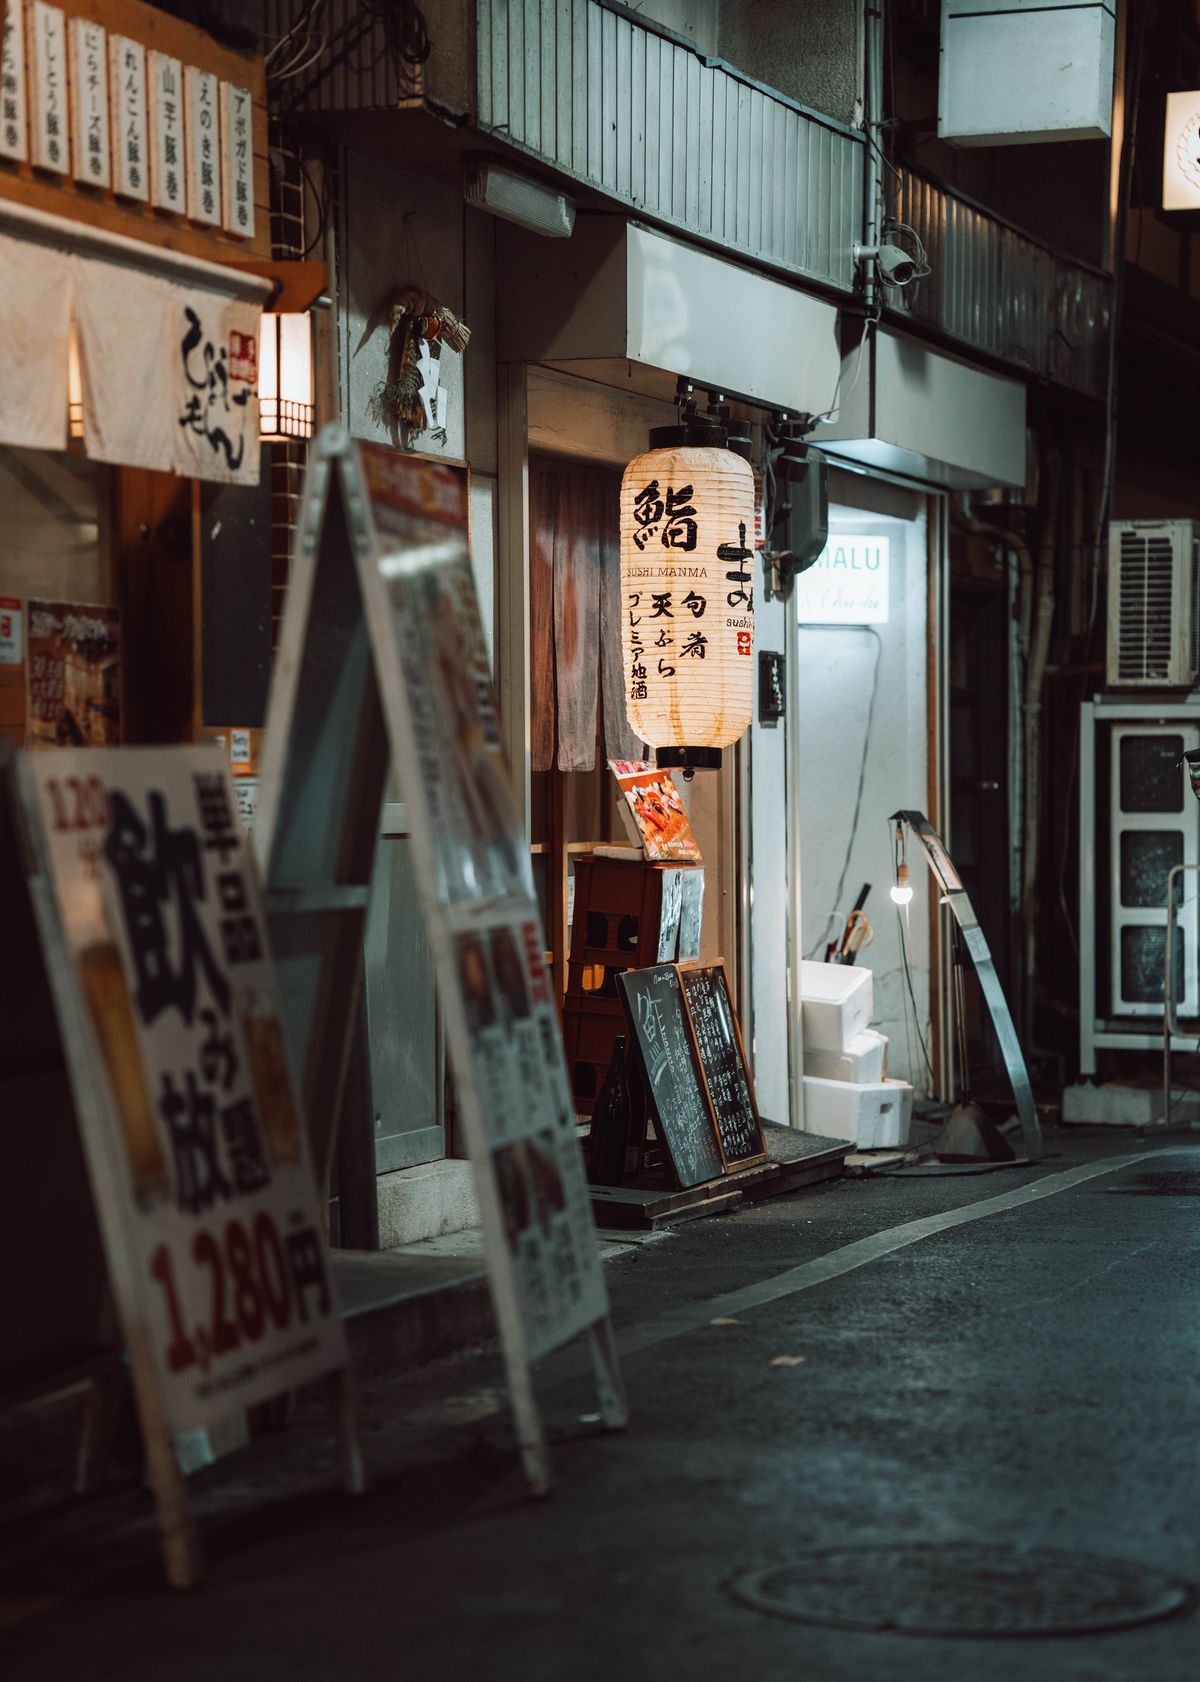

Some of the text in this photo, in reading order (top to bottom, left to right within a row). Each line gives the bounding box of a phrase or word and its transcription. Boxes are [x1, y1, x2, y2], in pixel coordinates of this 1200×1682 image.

[633, 480, 698, 552] 鮨
[626, 567, 708, 578] SUSHI MANMA
[628, 591, 648, 700] プレミア地酒
[648, 592, 675, 678] 天ぷら
